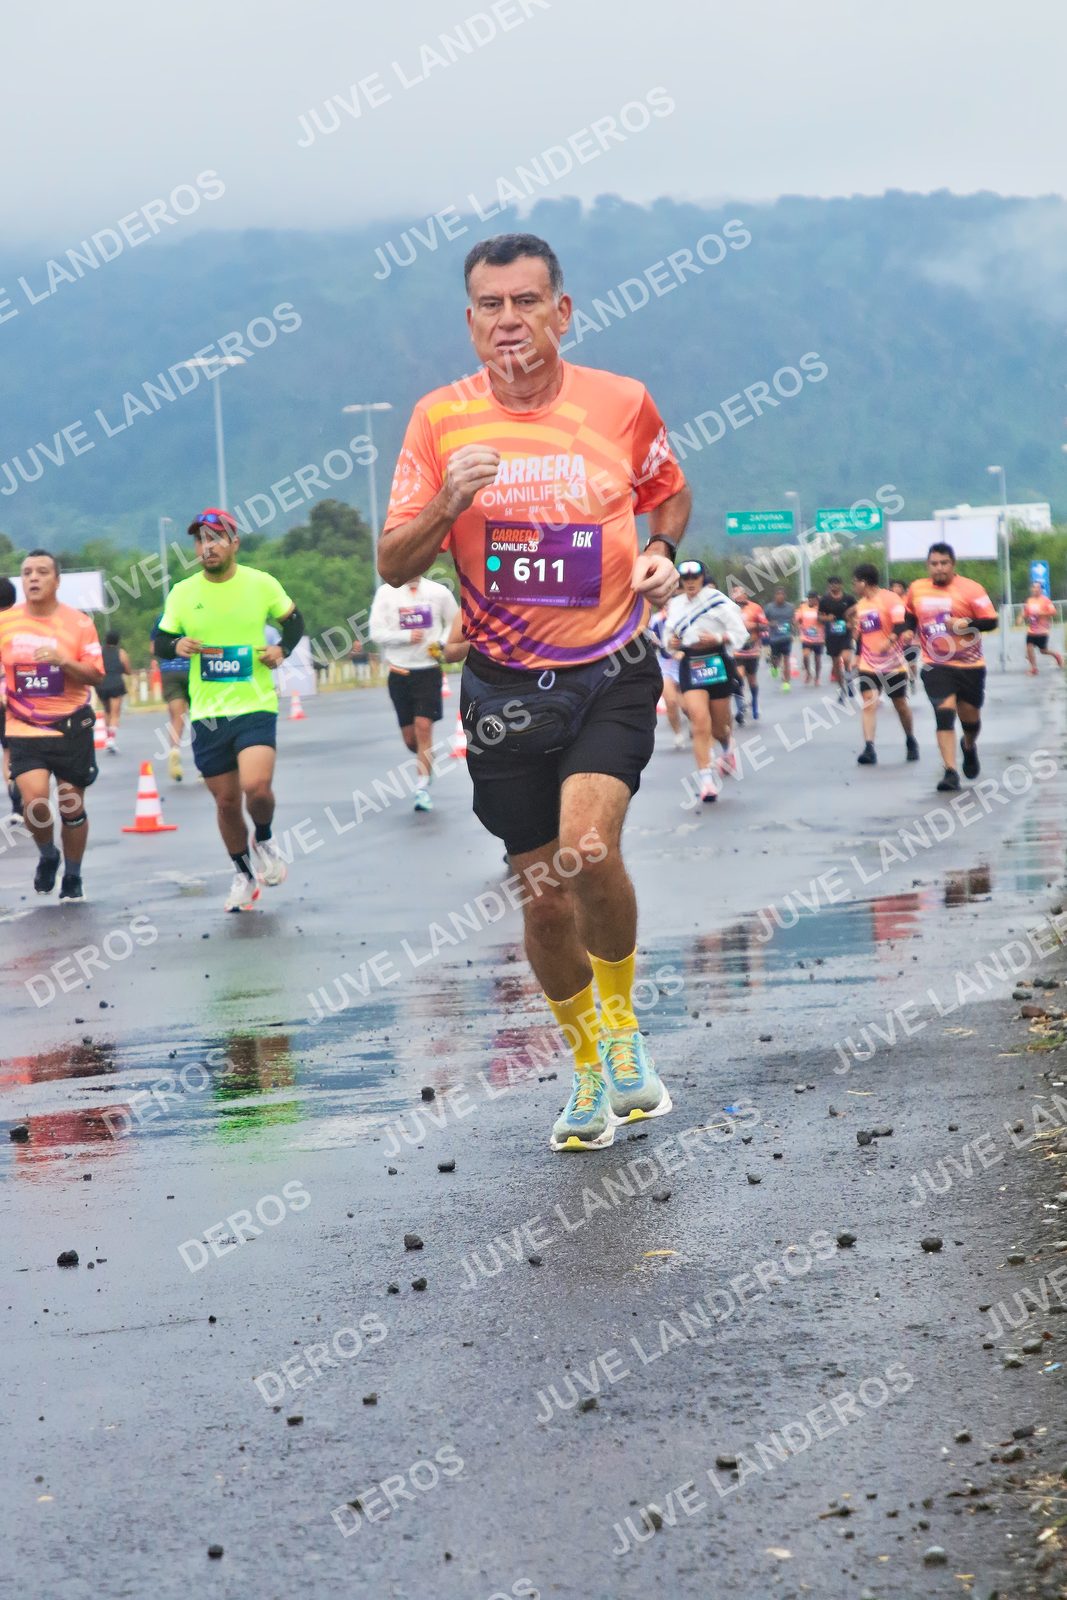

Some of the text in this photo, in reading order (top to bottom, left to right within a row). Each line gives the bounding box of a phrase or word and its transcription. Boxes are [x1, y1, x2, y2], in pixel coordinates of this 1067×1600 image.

[490, 454, 586, 486] ARRERA
[492, 528, 539, 542] CARRERA
[572, 530, 594, 549] 16K
[513, 556, 564, 583] 611
[207, 659, 240, 674] 1090
